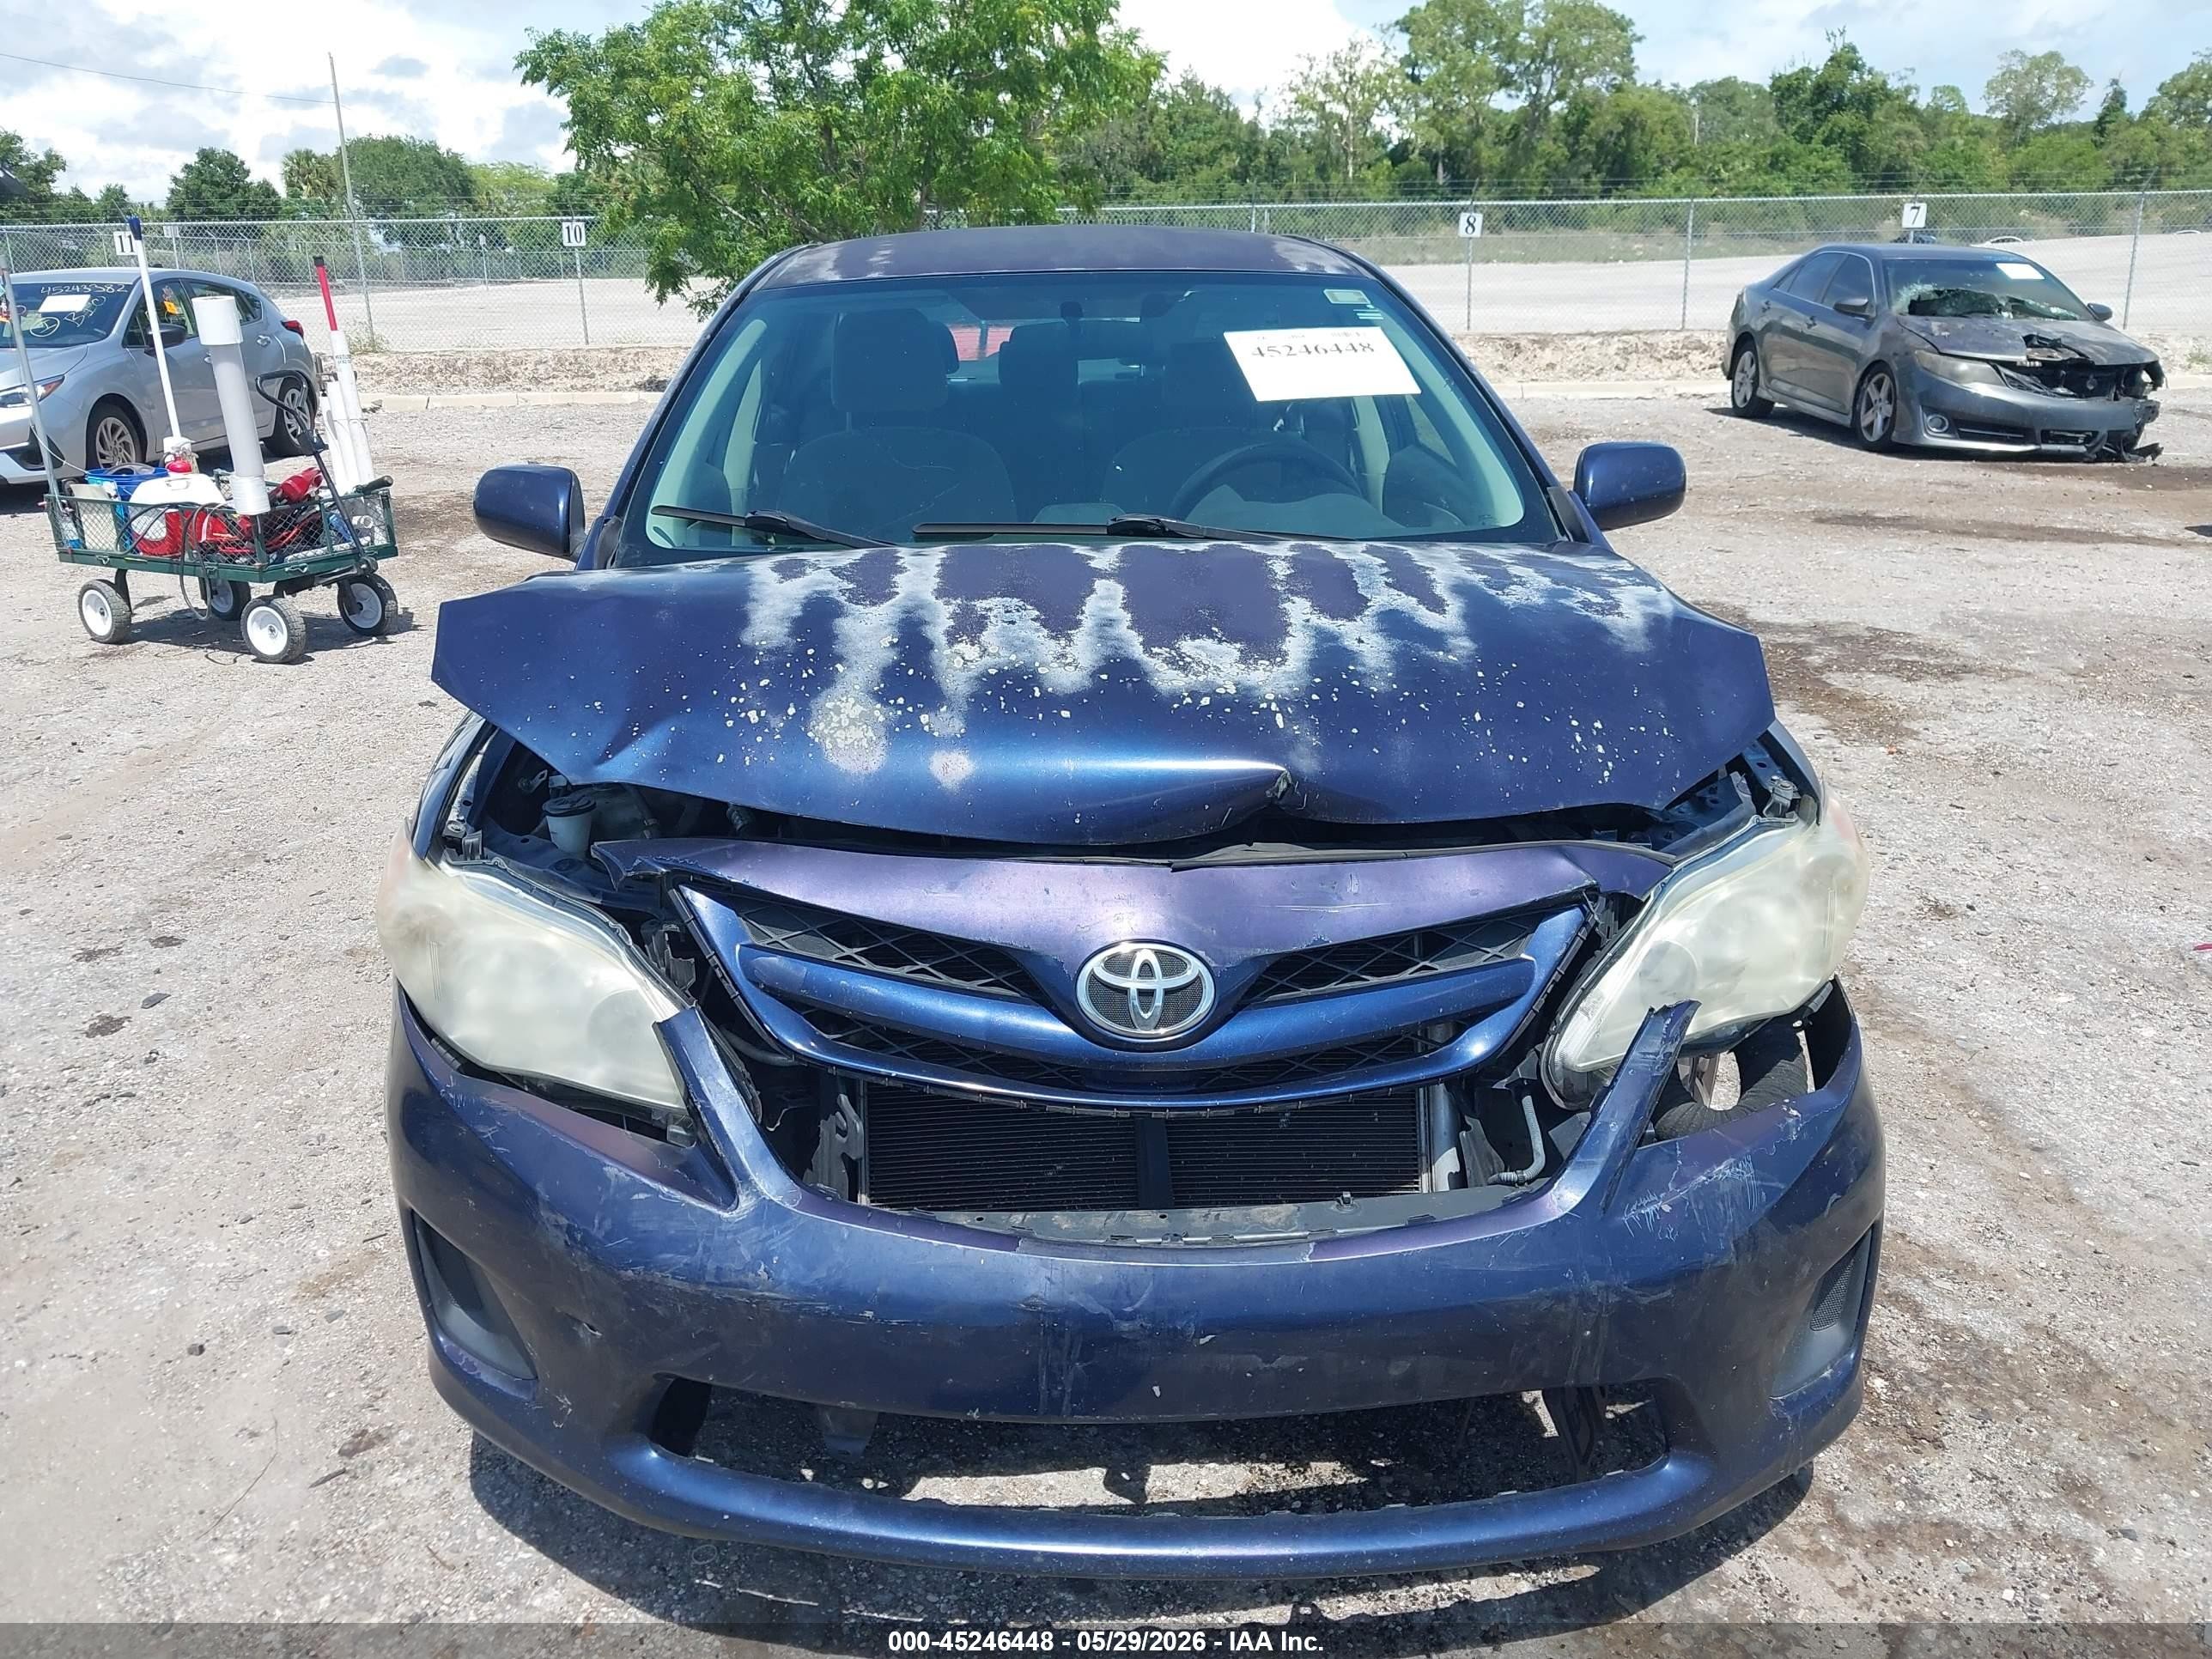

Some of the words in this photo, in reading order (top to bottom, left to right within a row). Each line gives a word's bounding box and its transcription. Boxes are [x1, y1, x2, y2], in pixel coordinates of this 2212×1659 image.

[1465, 215, 1476, 234] 8
[1911, 205, 1920, 225] 7
[118, 234, 134, 253] 11
[565, 224, 582, 244] 10
[40, 283, 129, 295] 45243382
[1251, 342, 1375, 358] 45246448
